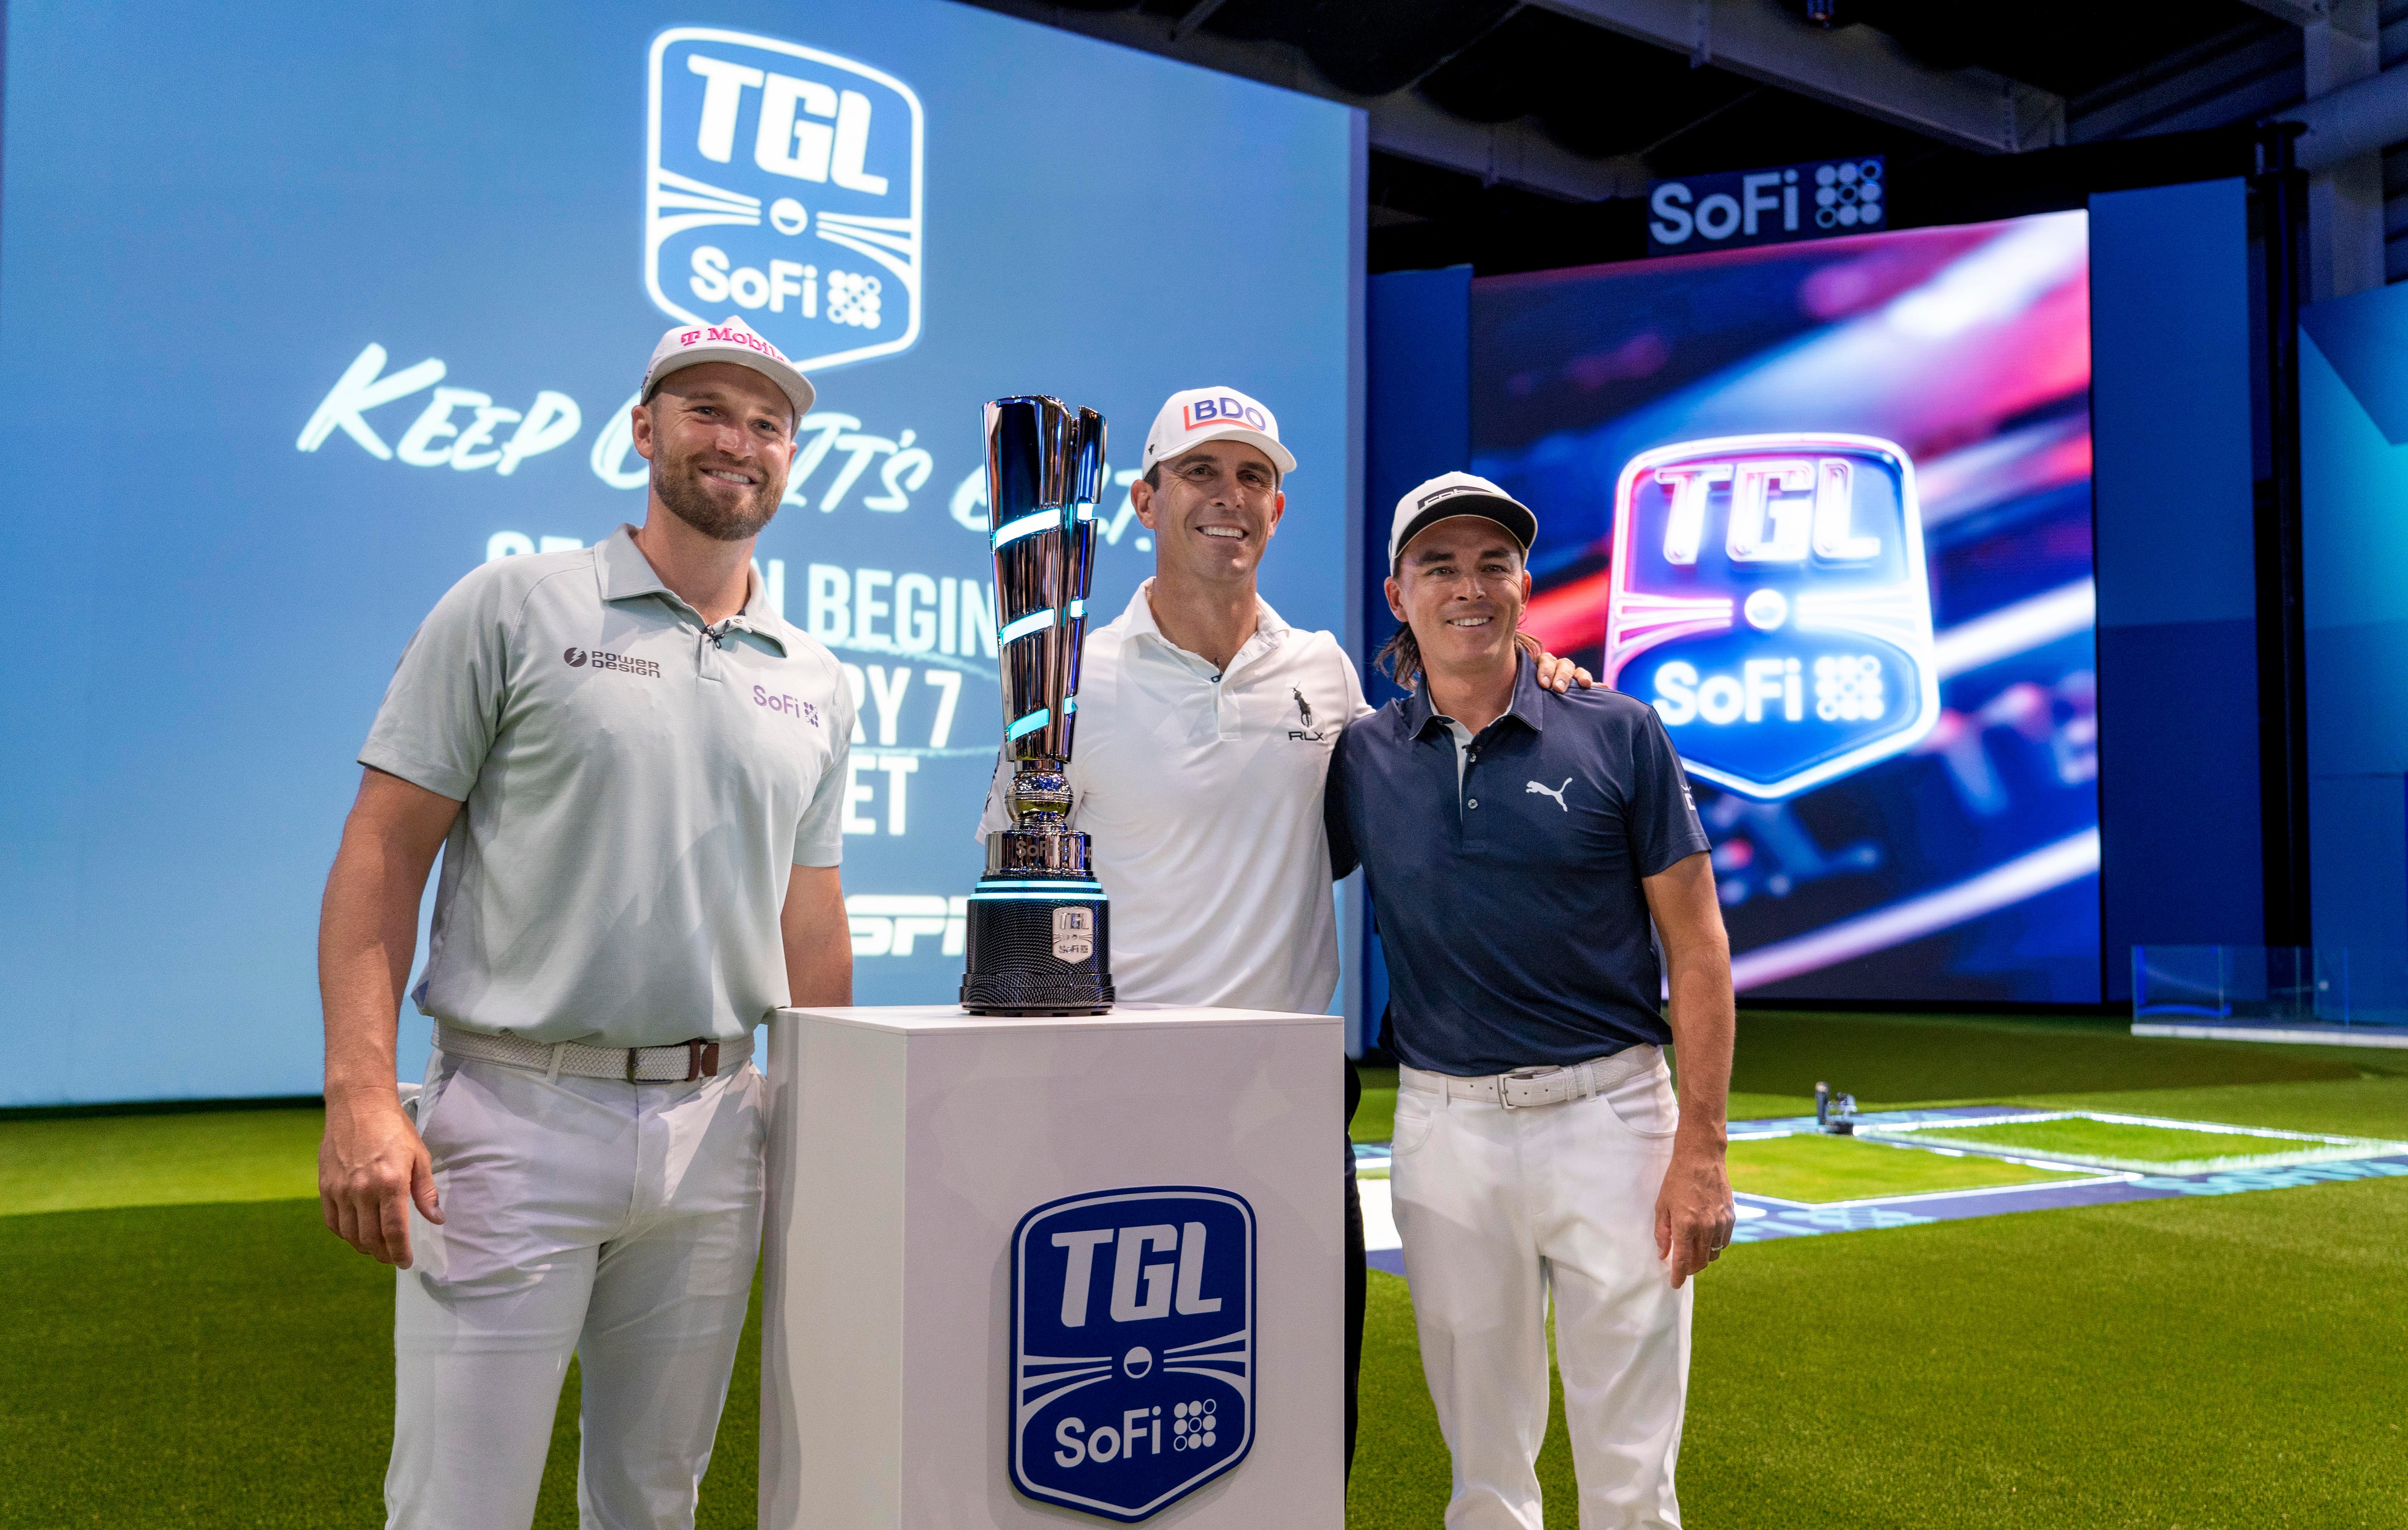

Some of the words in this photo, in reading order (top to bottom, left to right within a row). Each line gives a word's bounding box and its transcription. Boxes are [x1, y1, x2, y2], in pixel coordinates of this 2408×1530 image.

[687, 53, 889, 196] TGL
[1649, 169, 1799, 245] SoFi
[690, 245, 817, 318] SoFi
[1194, 397, 1266, 430] BDO
[1655, 457, 1881, 565] TGL
[807, 563, 998, 659] BEGIN
[753, 685, 800, 718] SoFi
[925, 669, 962, 748] 7
[1652, 658, 1802, 726] SoFi
[1288, 731, 1324, 741] RLX
[1016, 841, 1053, 857] SoFi
[1059, 912, 1089, 930] TGL
[1059, 945, 1079, 953] SoFi
[1051, 1221, 1222, 1328] TGL
[1054, 1405, 1161, 1468] SoFi
